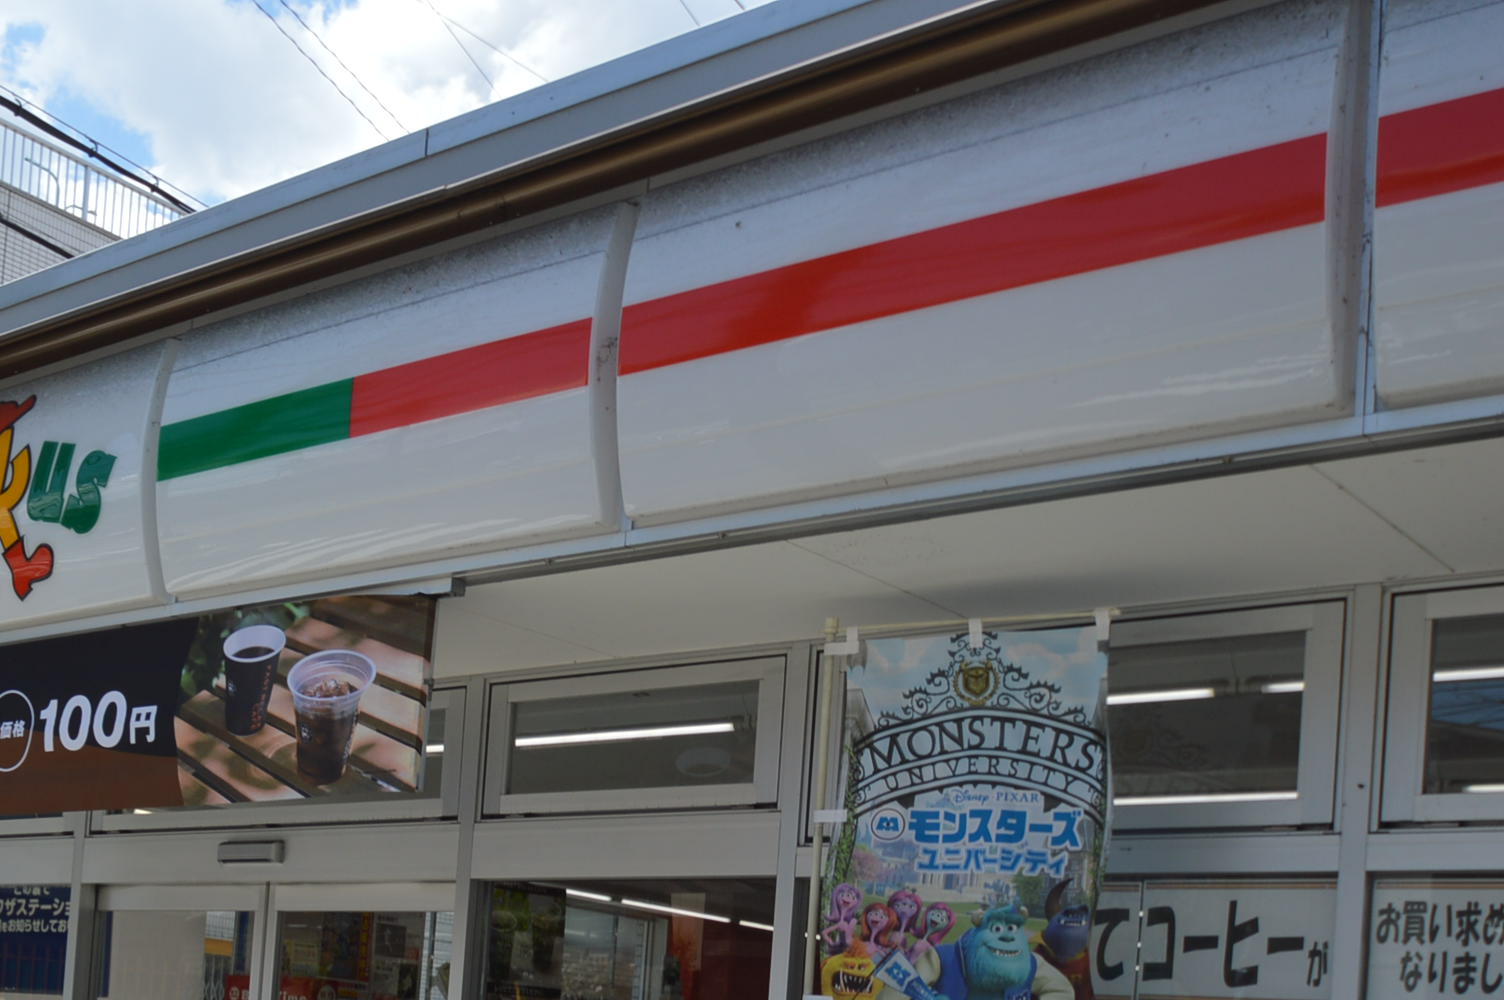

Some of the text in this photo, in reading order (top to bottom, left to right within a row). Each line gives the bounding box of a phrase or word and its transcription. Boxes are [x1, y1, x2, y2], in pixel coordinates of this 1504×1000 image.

[39, 689, 157, 753] 100円
[865, 715, 1096, 774] MONSTERS
[883, 755, 1078, 793] UNIVERSITY
[996, 791, 1039, 803] PIXAR
[908, 808, 1085, 849] モンスターズ
[917, 847, 1067, 877] ユニバーシティ
[1376, 900, 1503, 946] お買い求め
[1399, 950, 1503, 994] なりまし
